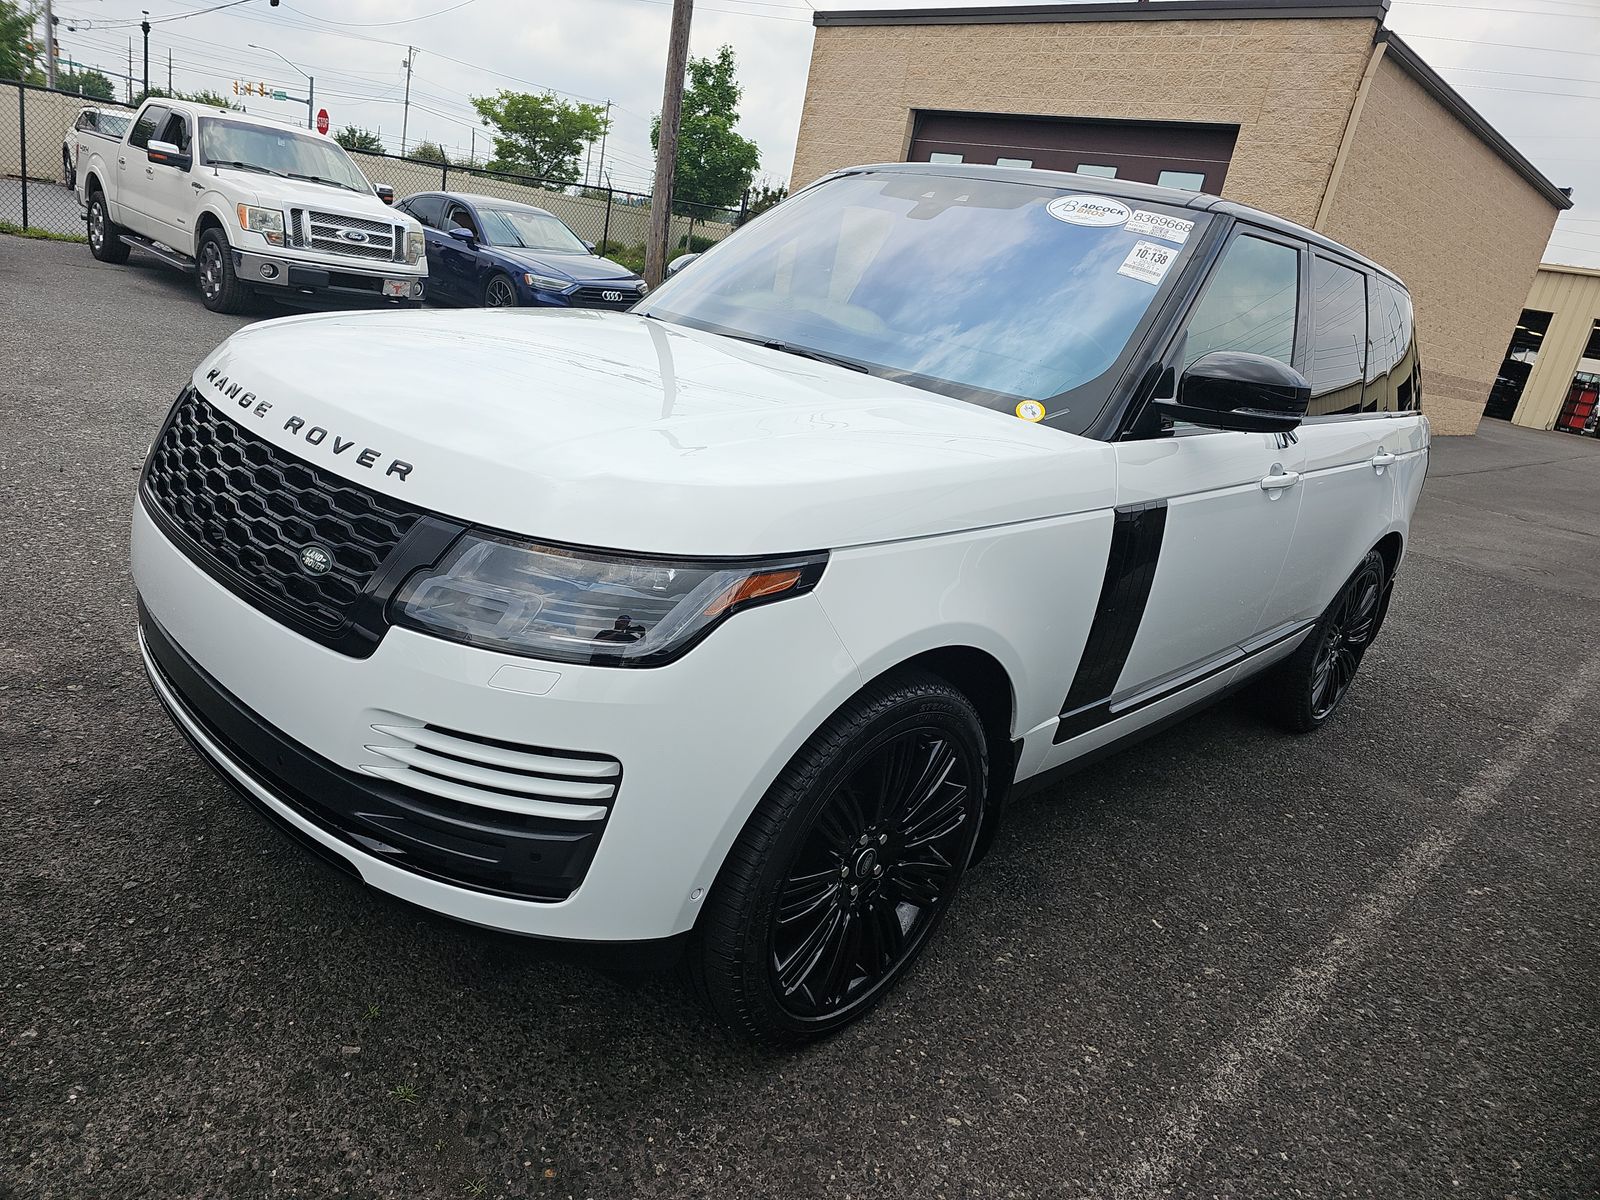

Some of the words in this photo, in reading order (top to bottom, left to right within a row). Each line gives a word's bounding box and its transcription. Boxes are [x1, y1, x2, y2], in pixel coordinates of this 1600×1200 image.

[1076, 207, 1106, 218] BROS
[1081, 203, 1127, 216] ADCOCK
[1133, 212, 1192, 233] 8369668
[1135, 248, 1169, 265] 10:138
[206, 368, 273, 418] RANGE
[283, 415, 414, 482] ROVER
[304, 556, 326, 573] ROVER
